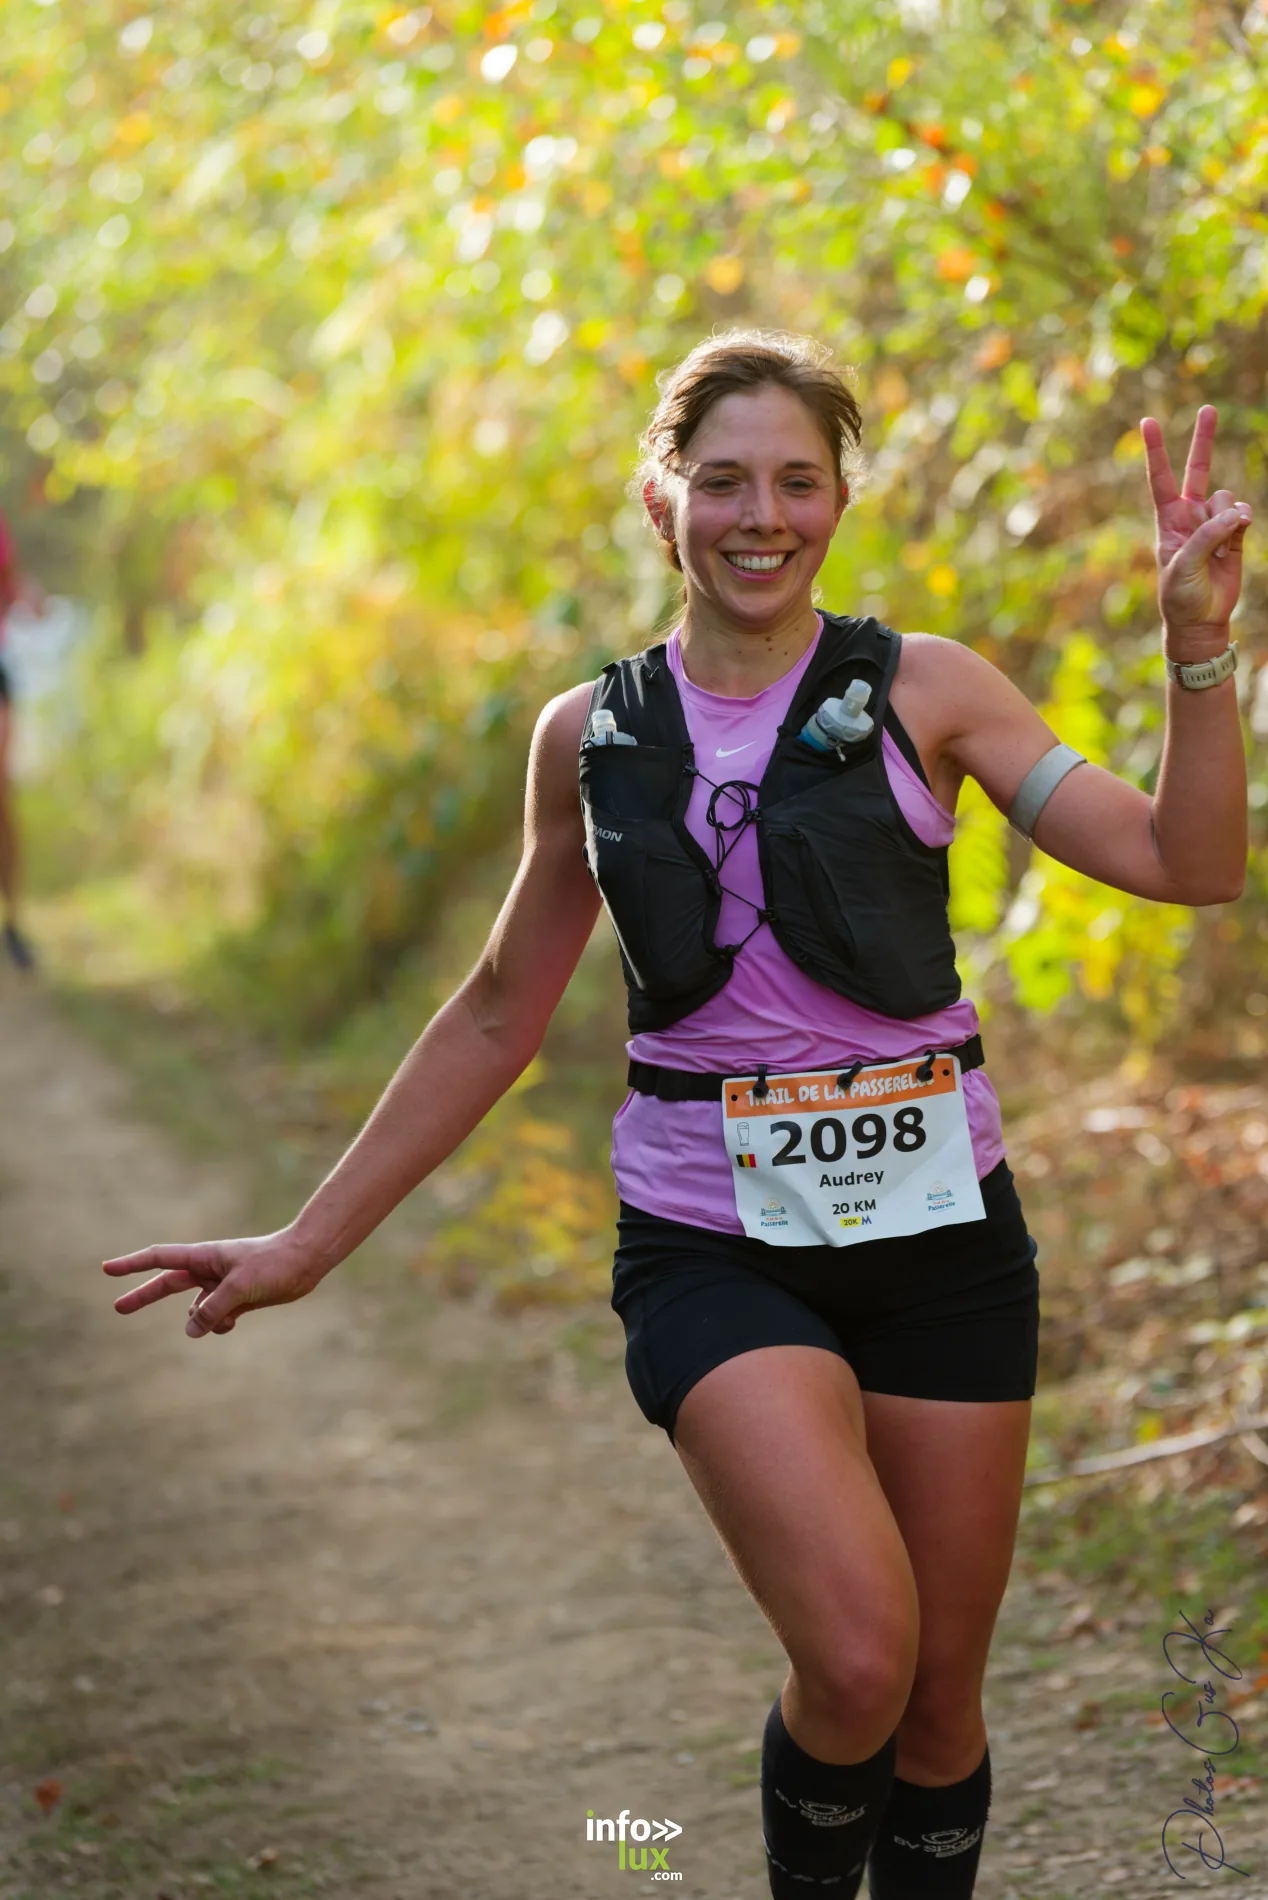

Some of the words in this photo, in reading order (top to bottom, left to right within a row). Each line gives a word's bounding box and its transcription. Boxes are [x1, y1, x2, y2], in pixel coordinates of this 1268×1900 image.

[798, 1084, 820, 1102] DE
[823, 1084, 846, 1100] LA
[769, 1106, 927, 1167] 2098
[819, 1170, 885, 1188] Audrey
[831, 1202, 850, 1215] 20
[854, 1198, 877, 1212] KM
[843, 1218, 859, 1226] 20K
